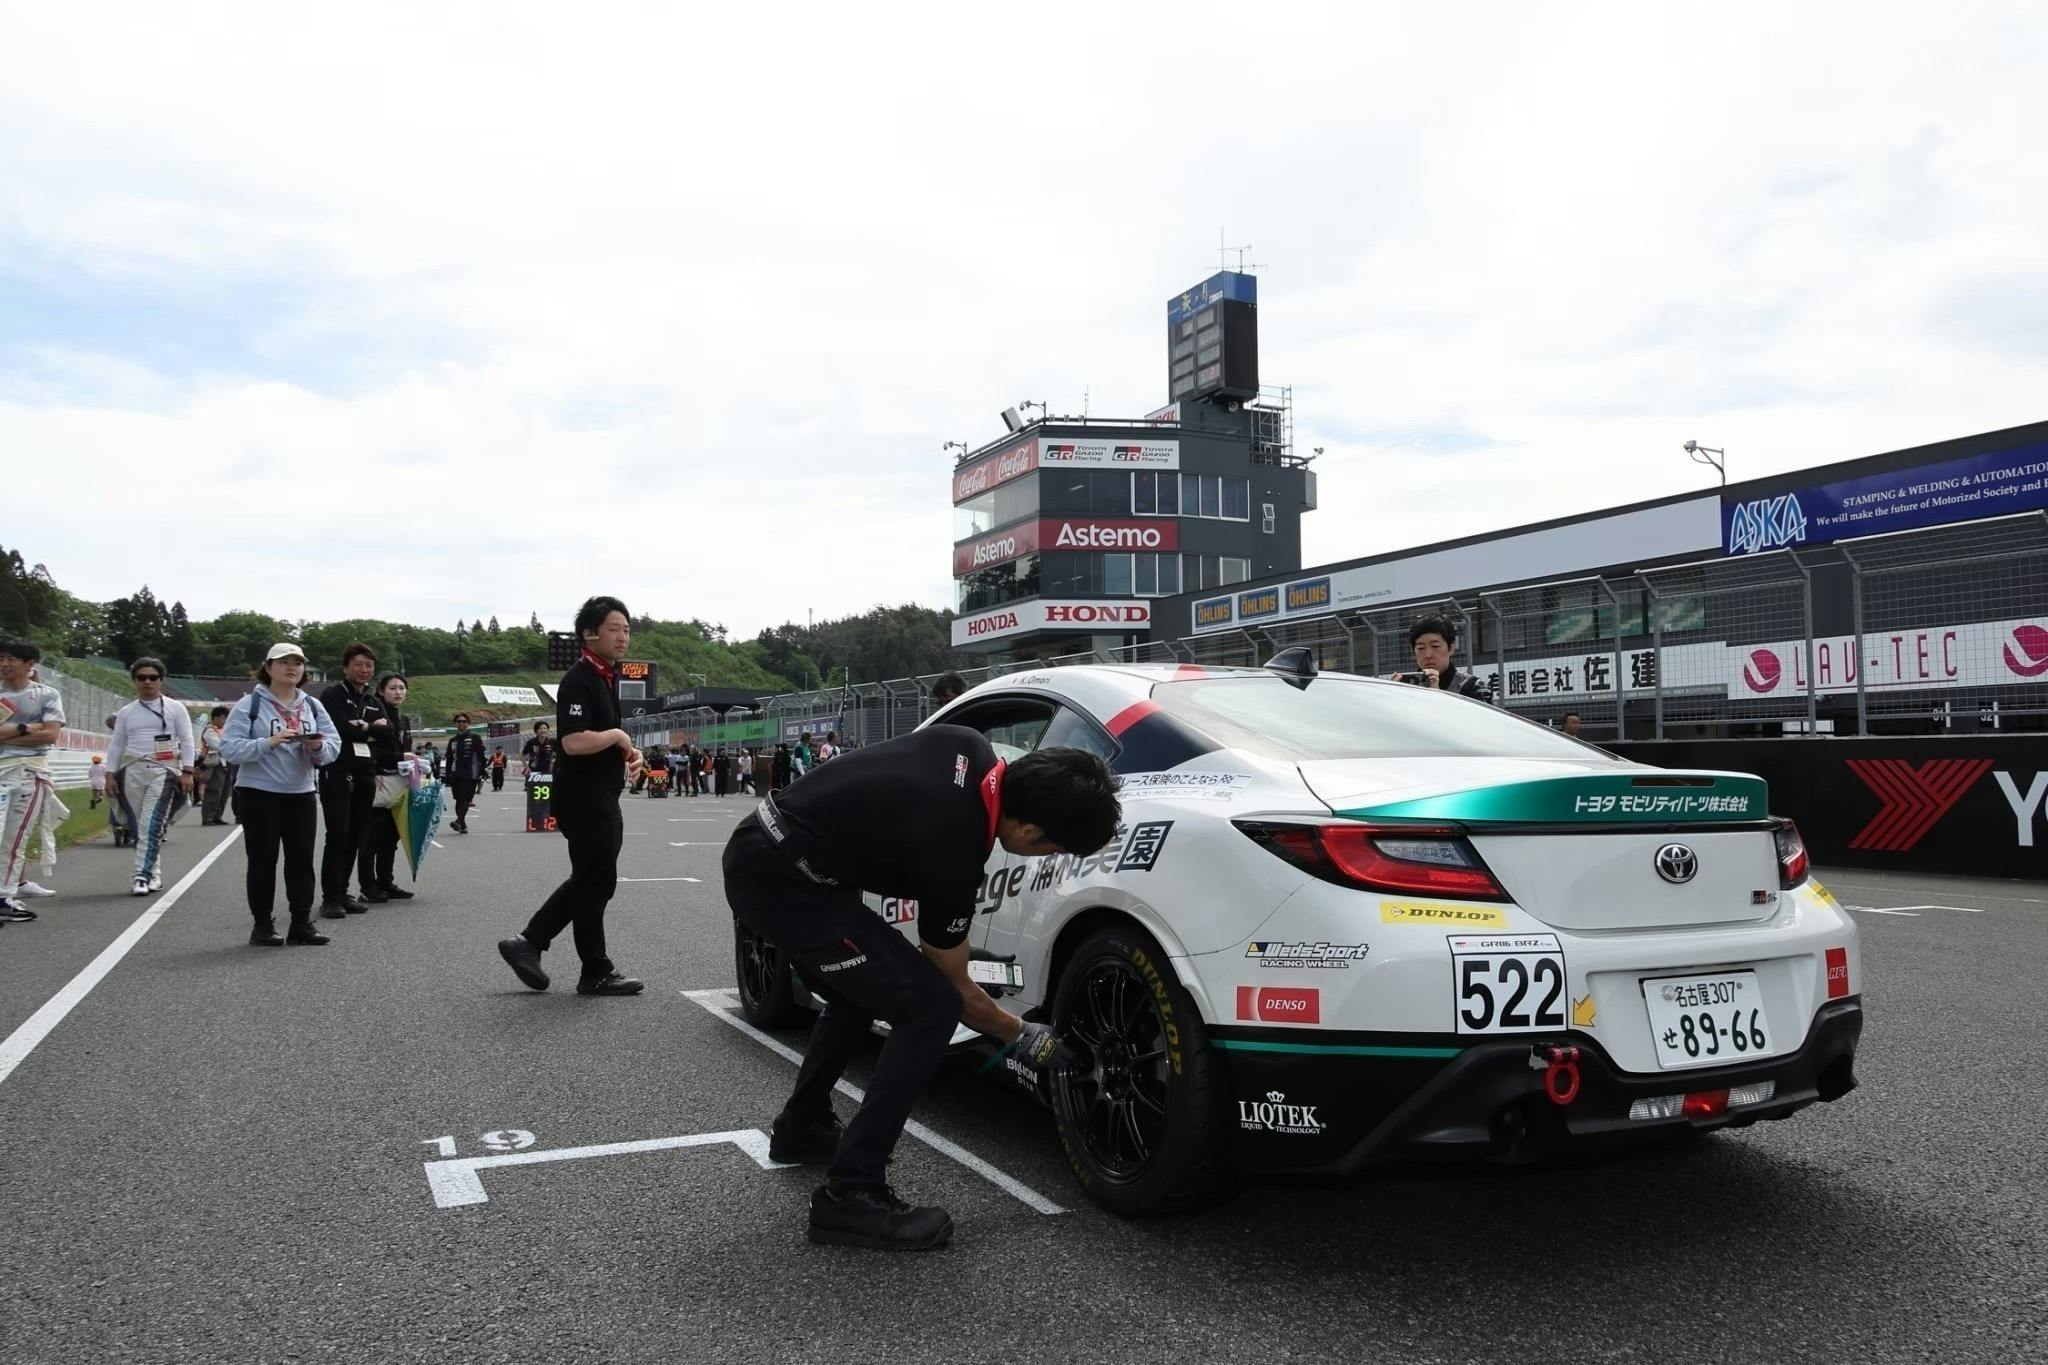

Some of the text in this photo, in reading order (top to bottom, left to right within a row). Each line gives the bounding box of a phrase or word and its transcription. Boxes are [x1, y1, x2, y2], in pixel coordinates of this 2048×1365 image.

[1046, 449, 1074, 461] GR
[1112, 451, 1141, 462] GR
[1842, 461, 2048, 508] STAMPING & WELDING & AUTOMATIO
[1816, 479, 2041, 526] We will make the future of Motorized Society and
[1055, 522, 1161, 547] Astemo
[1729, 492, 1807, 555] ASKA
[972, 536, 1015, 567] Astemo
[1241, 591, 1276, 616] ÖHLINS
[1289, 583, 1328, 606] ÖHLINS
[967, 611, 1019, 637] HONDA
[1045, 605, 1150, 622] HOND
[1197, 603, 1230, 624] ÖHLINS
[270, 718, 312, 738] GP
[533, 786, 550, 800] 39
[1575, 795, 1749, 813] トヨタ モビリティパーツ株式会社
[1992, 770, 2048, 847] Y
[882, 897, 915, 923] GR
[1409, 907, 1497, 922] DUNLOP
[1264, 941, 1370, 960] WedsSport
[1260, 959, 1350, 969] RACING WHEEL
[1265, 998, 1307, 1012] DENSO
[1460, 957, 1565, 1031] 522
[1675, 981, 1736, 1008] 名古屋 307
[1662, 1007, 1766, 1058] せ 89-66
[1006, 1057, 1038, 1084] BILLION
[1238, 1100, 1321, 1129] LIQTEK
[1240, 1121, 1322, 1135] LIQUID TECHNOLOGY
[419, 1129, 537, 1157] 19
